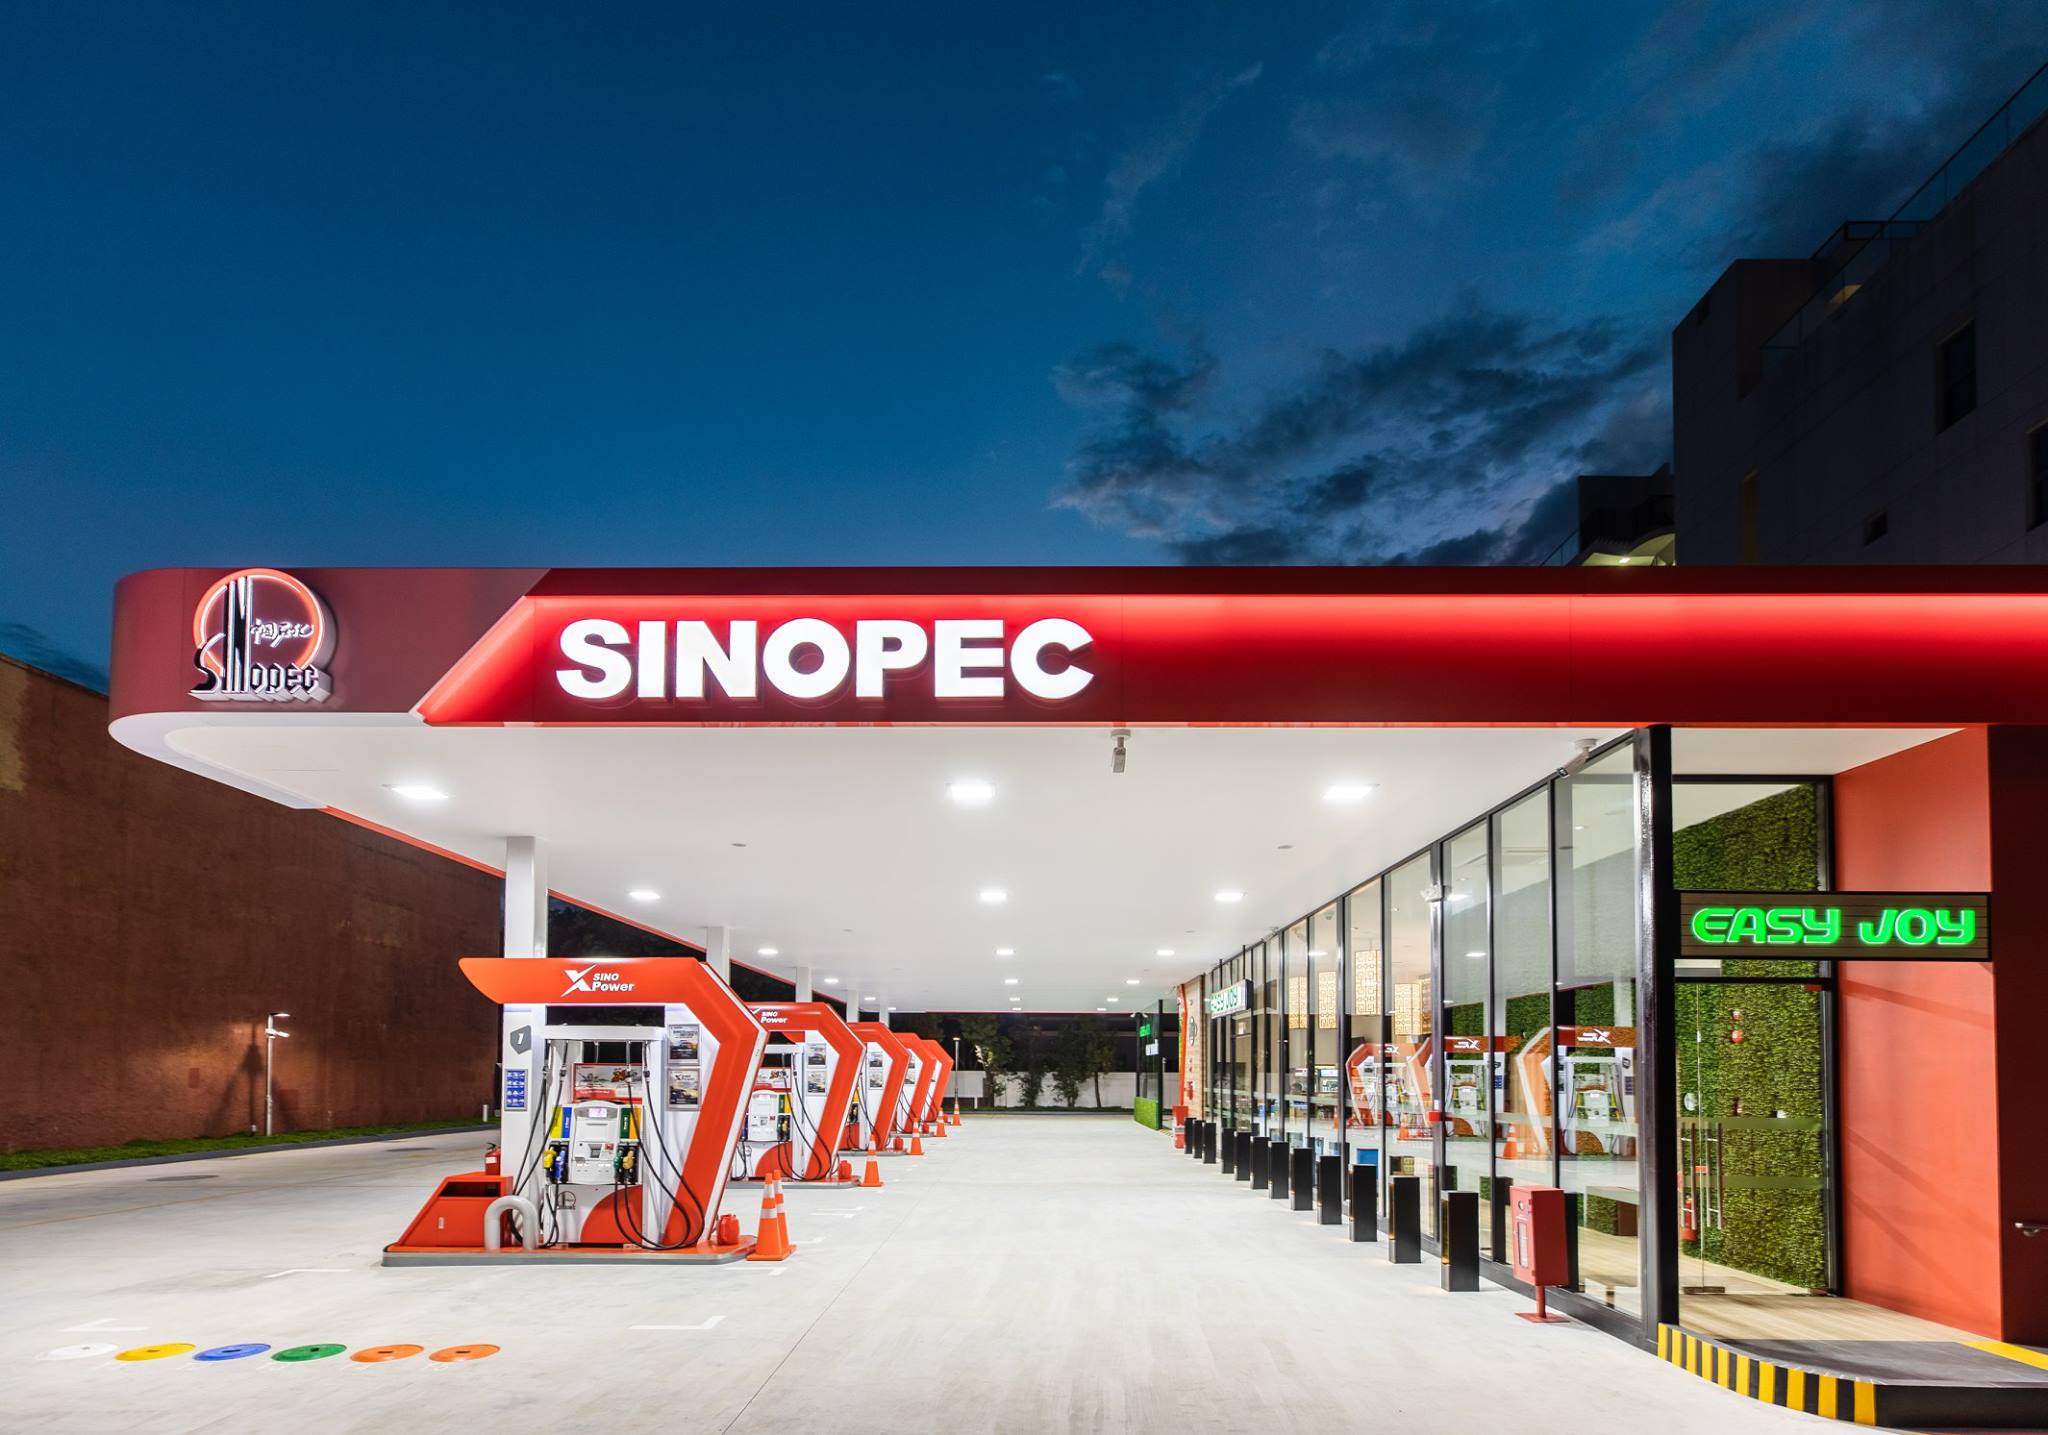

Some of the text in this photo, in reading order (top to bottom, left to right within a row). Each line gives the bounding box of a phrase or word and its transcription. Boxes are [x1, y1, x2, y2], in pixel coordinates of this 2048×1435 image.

[556, 617, 1094, 699] SINOPEC
[1691, 907, 1976, 944] EASY JOY
[593, 972, 620, 982] SINO
[591, 981, 635, 992] Power
[760, 1016, 788, 1024] Power
[517, 1032, 525, 1045] 1
